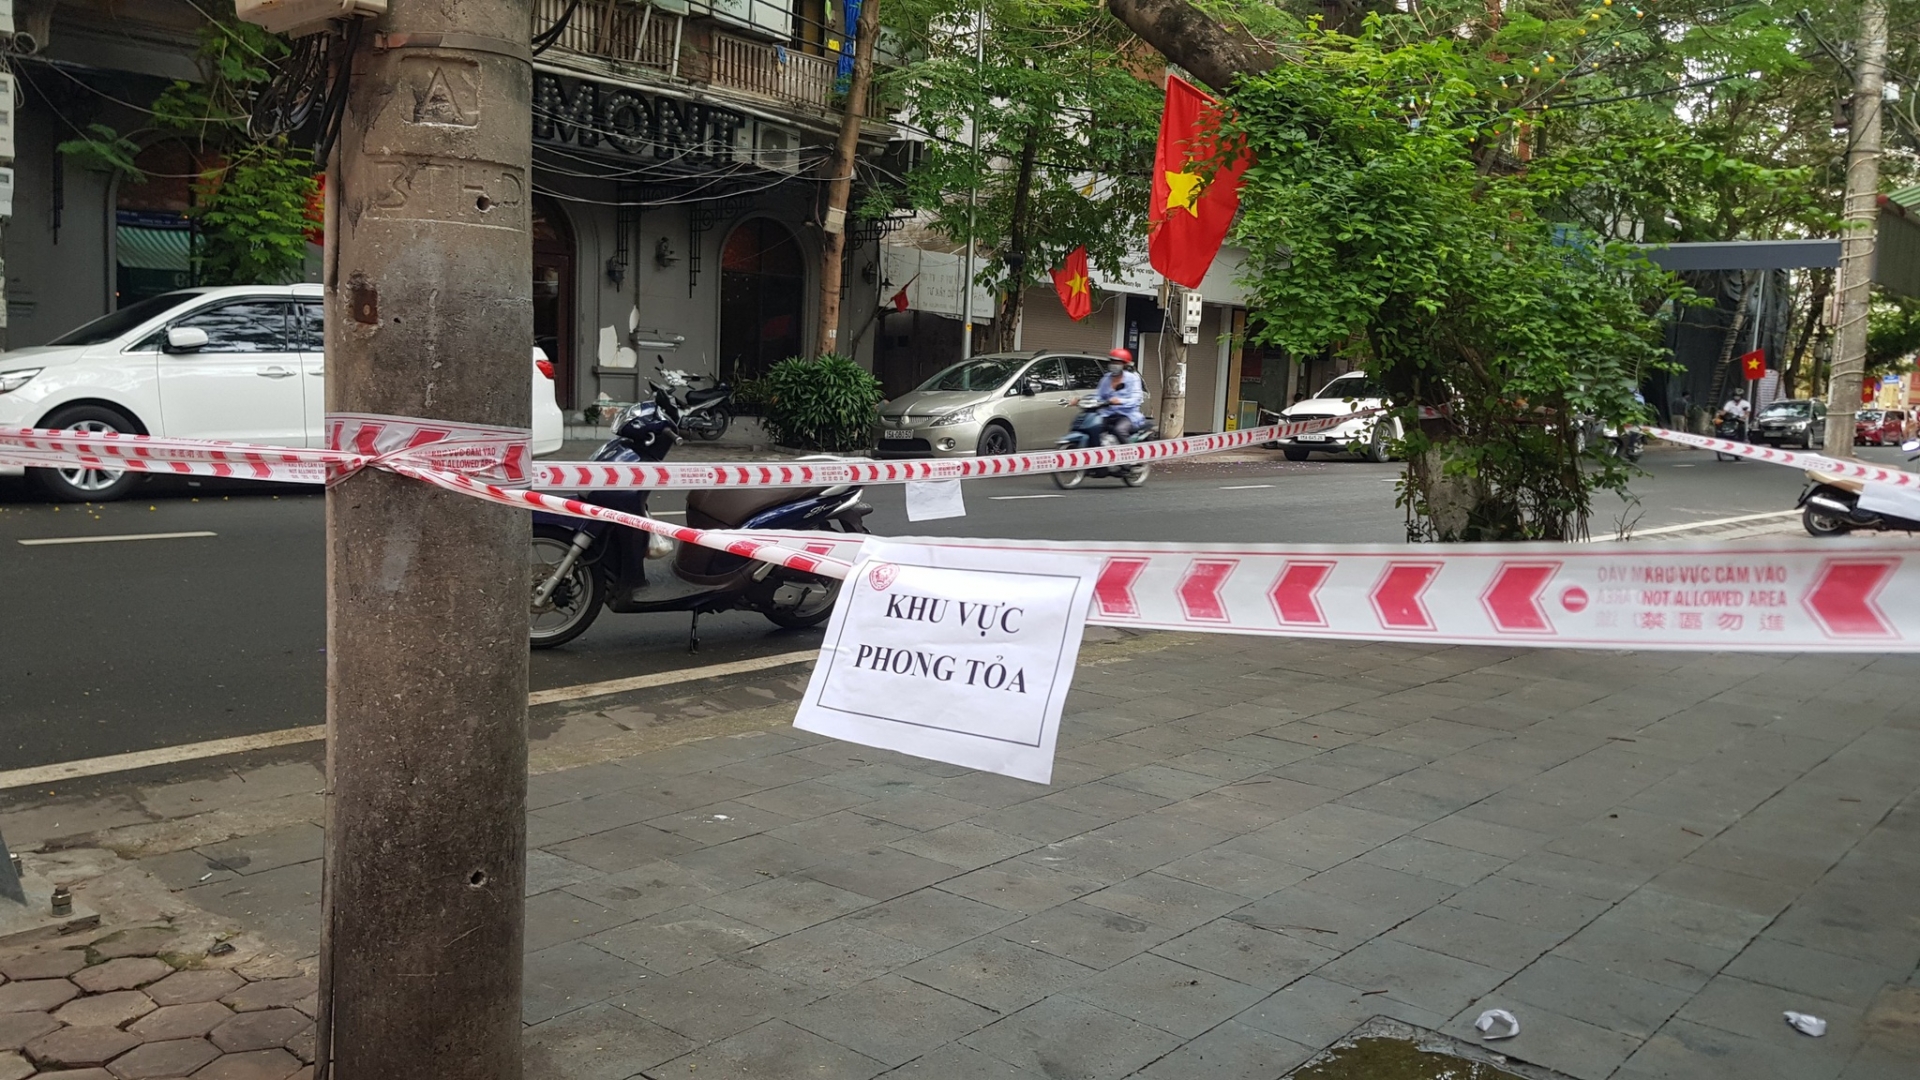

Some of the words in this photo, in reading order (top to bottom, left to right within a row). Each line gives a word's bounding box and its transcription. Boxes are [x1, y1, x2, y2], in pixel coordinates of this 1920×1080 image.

[447, 459, 480, 469] ALLOWED
[1643, 590, 1671, 606] NOT
[1674, 590, 1743, 607] ALLOWED
[1749, 591, 1787, 607] AREA
[883, 593, 949, 624] KHU
[958, 602, 1025, 637] VỰC
[853, 644, 957, 682] PHONG
[965, 655, 1027, 694] TỎA
